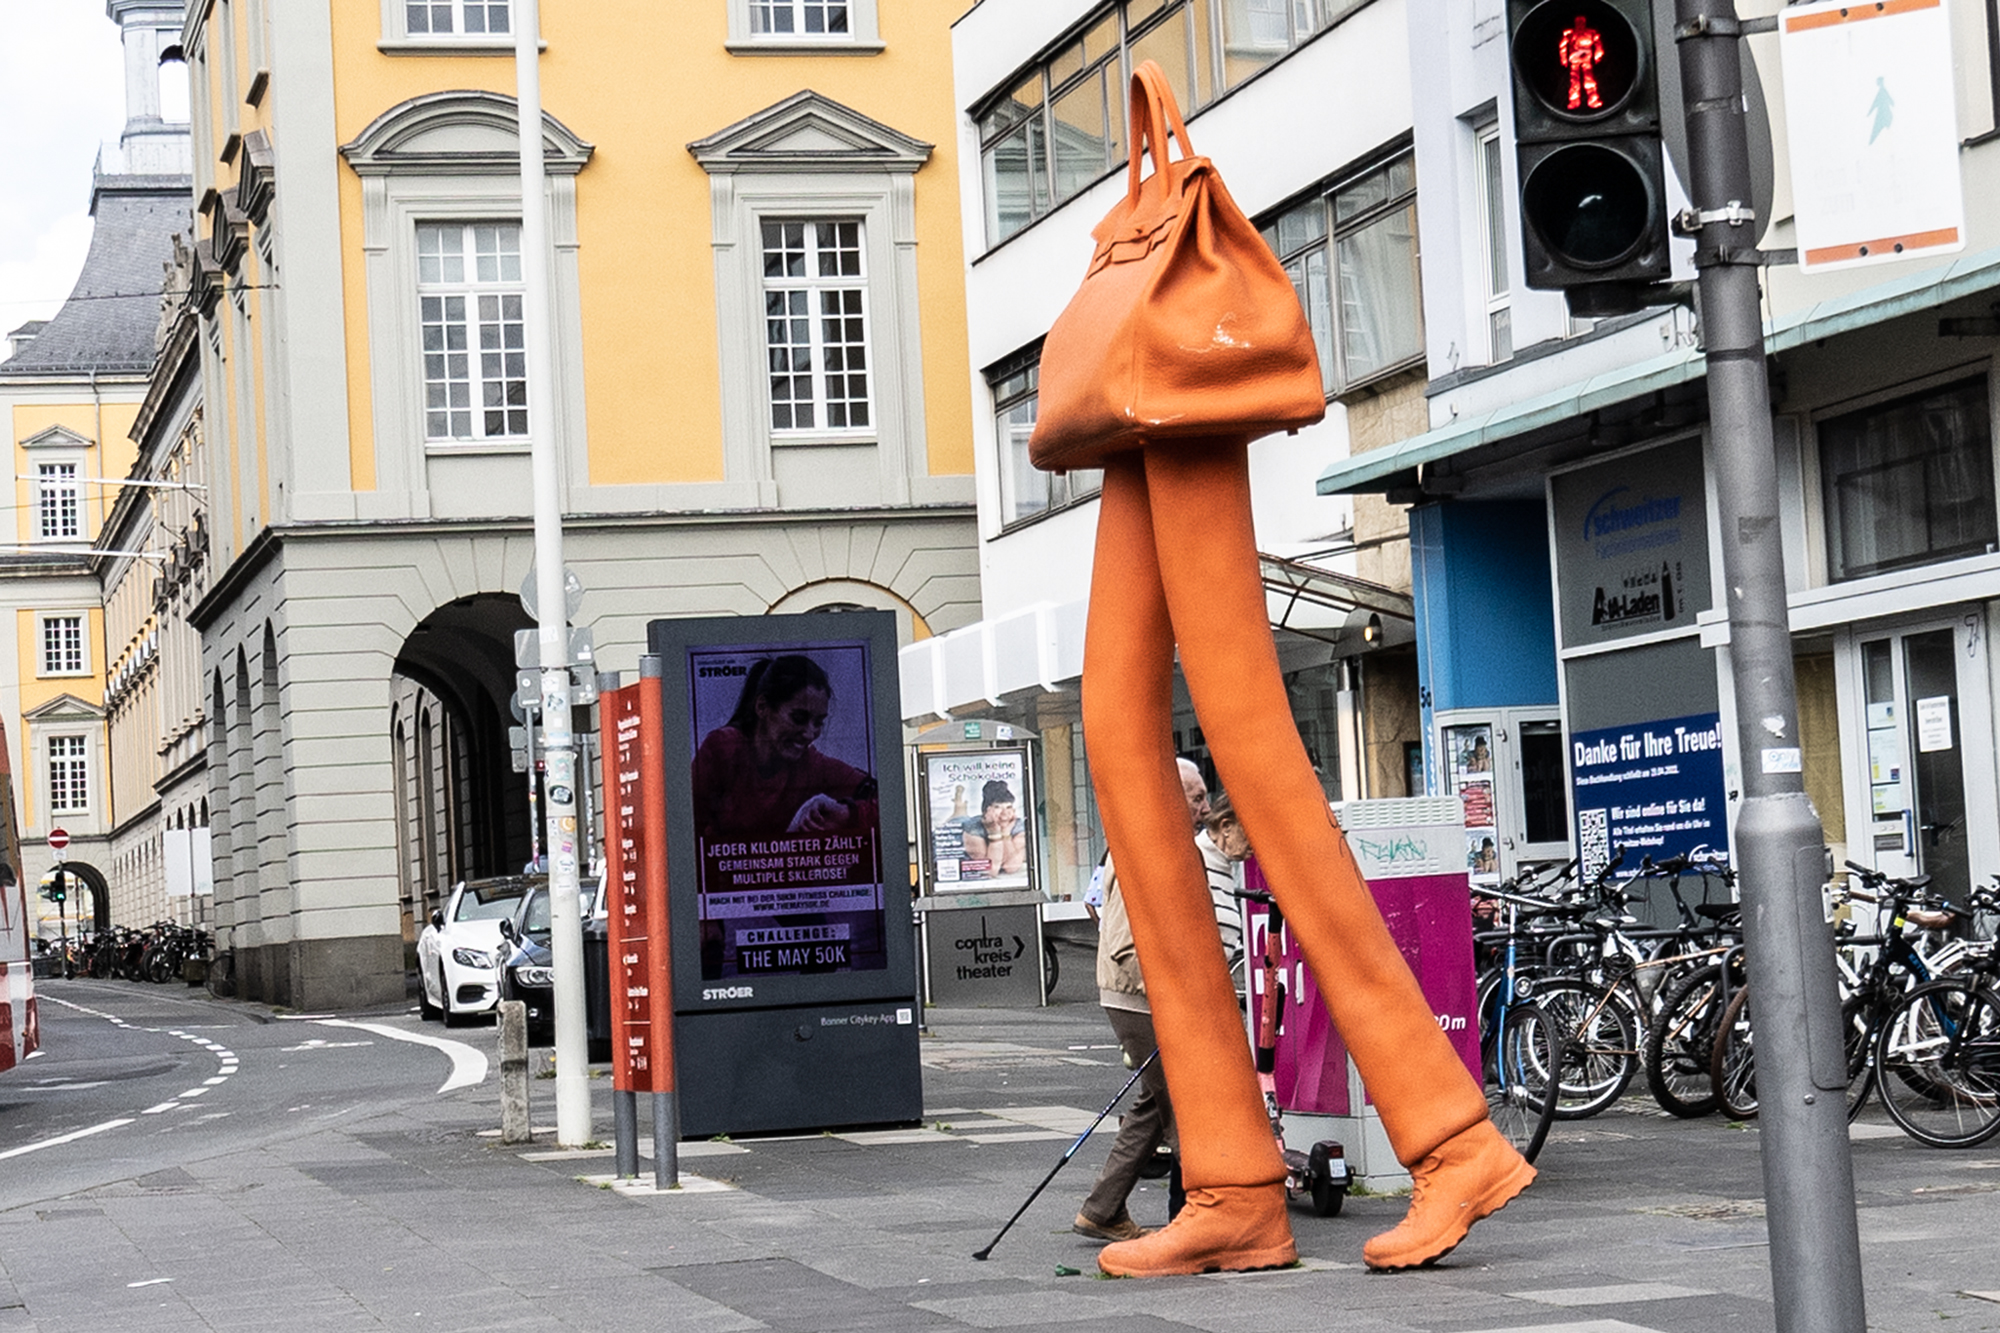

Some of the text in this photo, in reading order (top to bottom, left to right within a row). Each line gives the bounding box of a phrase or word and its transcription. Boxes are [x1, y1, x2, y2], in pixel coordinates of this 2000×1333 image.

[1574, 722, 1722, 767] Danke für Ihre Treue!
[943, 761, 1016, 772] Ich will keine
[948, 771, 1016, 784] Schokolade
[1611, 797, 1706, 820] Wir sind online für Sie da!
[707, 843, 747, 857] JEDER
[750, 838, 821, 855] KILOMETER
[718, 853, 860, 872] GEMEINSAM STARK GEGEN
[732, 868, 847, 885] MULTIPLE SKLEROSE!
[747, 927, 836, 943] CHALLENGE:
[742, 946, 846, 968] THE MAY 50K
[974, 949, 1012, 964] kreis
[956, 964, 1013, 980] theater
[820, 1017, 849, 1027] Bonner
